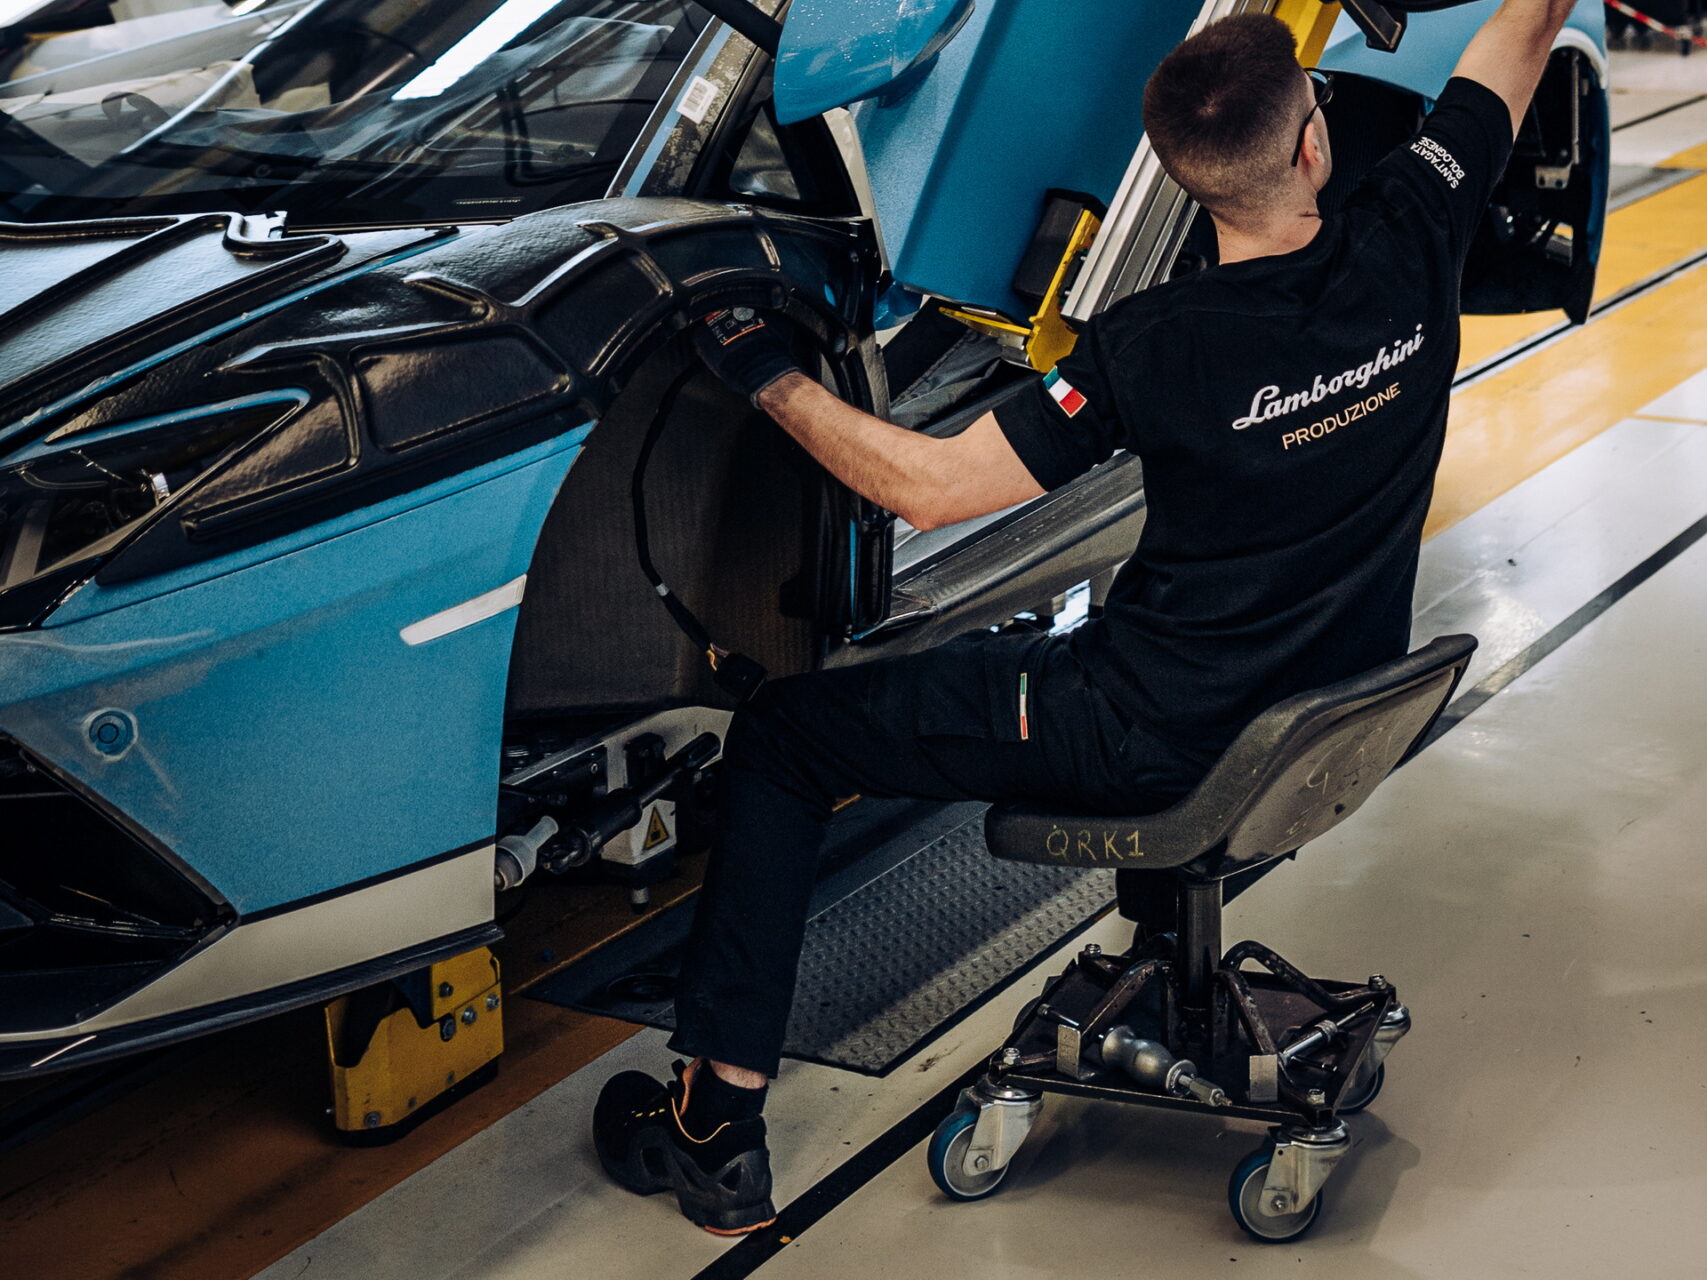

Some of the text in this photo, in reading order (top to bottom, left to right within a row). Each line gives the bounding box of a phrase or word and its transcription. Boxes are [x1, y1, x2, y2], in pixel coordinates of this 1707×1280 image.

[1410, 142, 1459, 189] SANT'AGATA
[1418, 136, 1465, 179] BOLOGNESE
[1231, 323, 1424, 430] Lamborghini
[1282, 382, 1401, 450] PRODUZIONE
